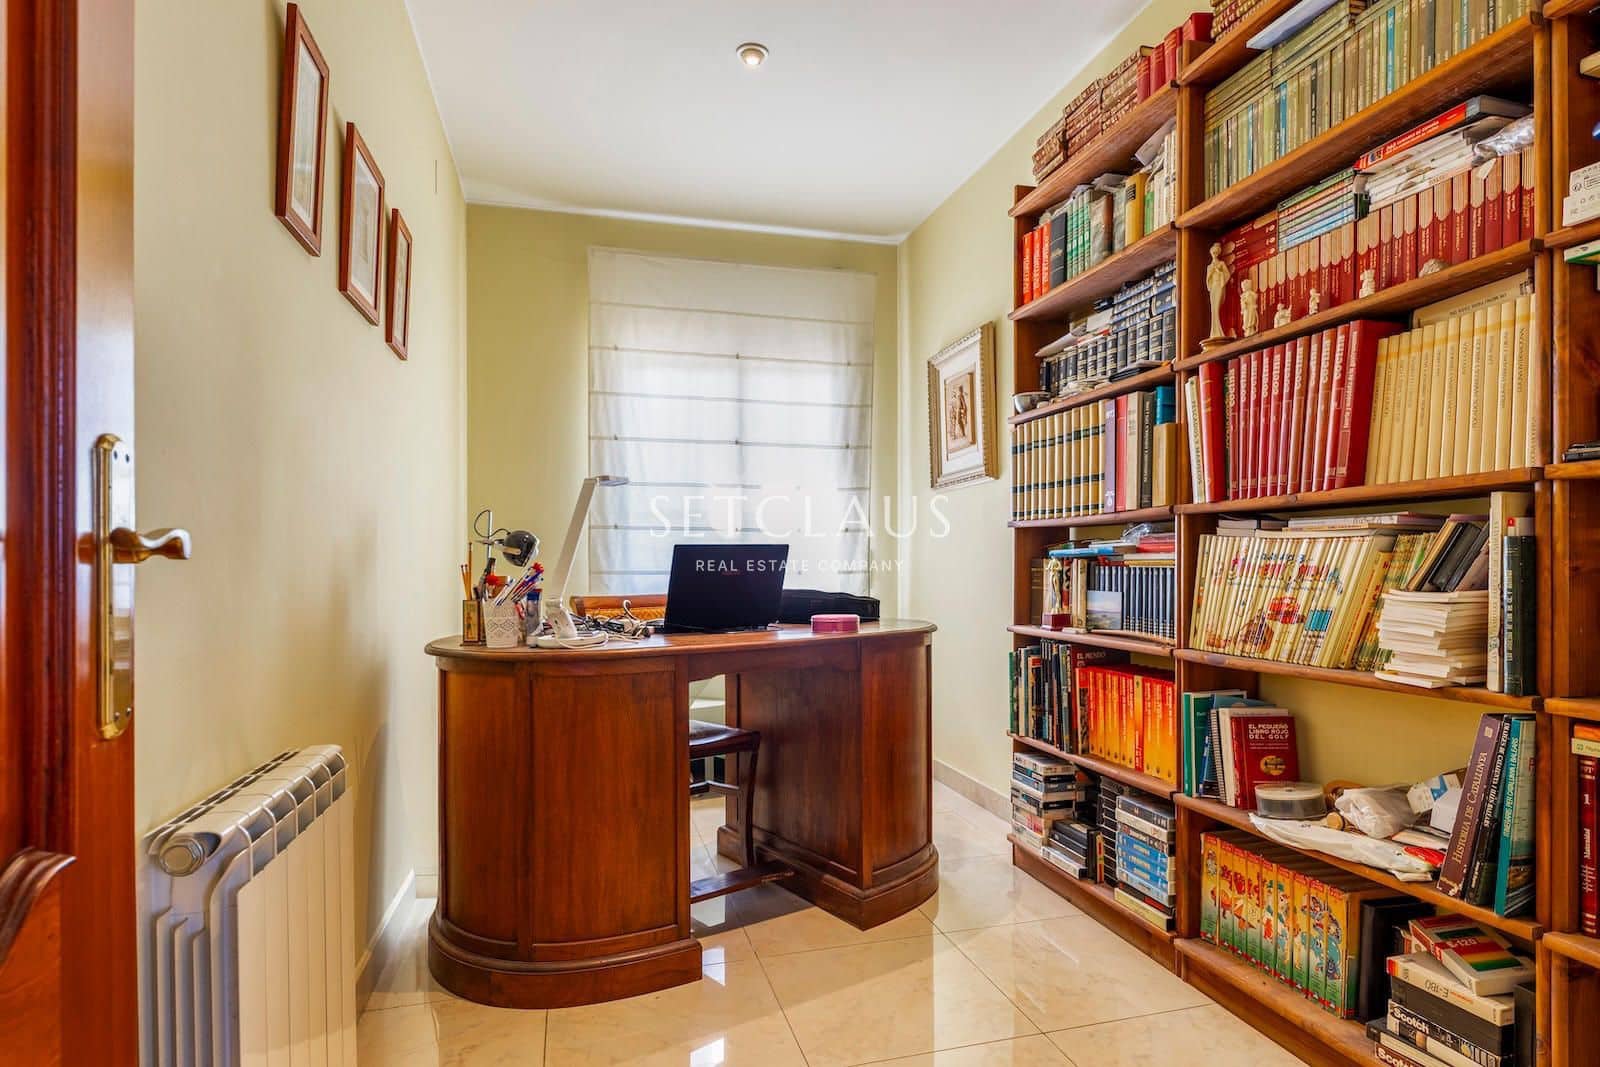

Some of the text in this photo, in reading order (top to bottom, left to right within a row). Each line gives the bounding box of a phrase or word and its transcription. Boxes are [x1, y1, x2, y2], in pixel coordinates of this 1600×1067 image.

[1467, 752, 1488, 804] CATALUNYA
[1463, 806, 1474, 820] DE
[1393, 1007, 1430, 1034] Scotch
[1377, 1047, 1413, 1067] Scot
